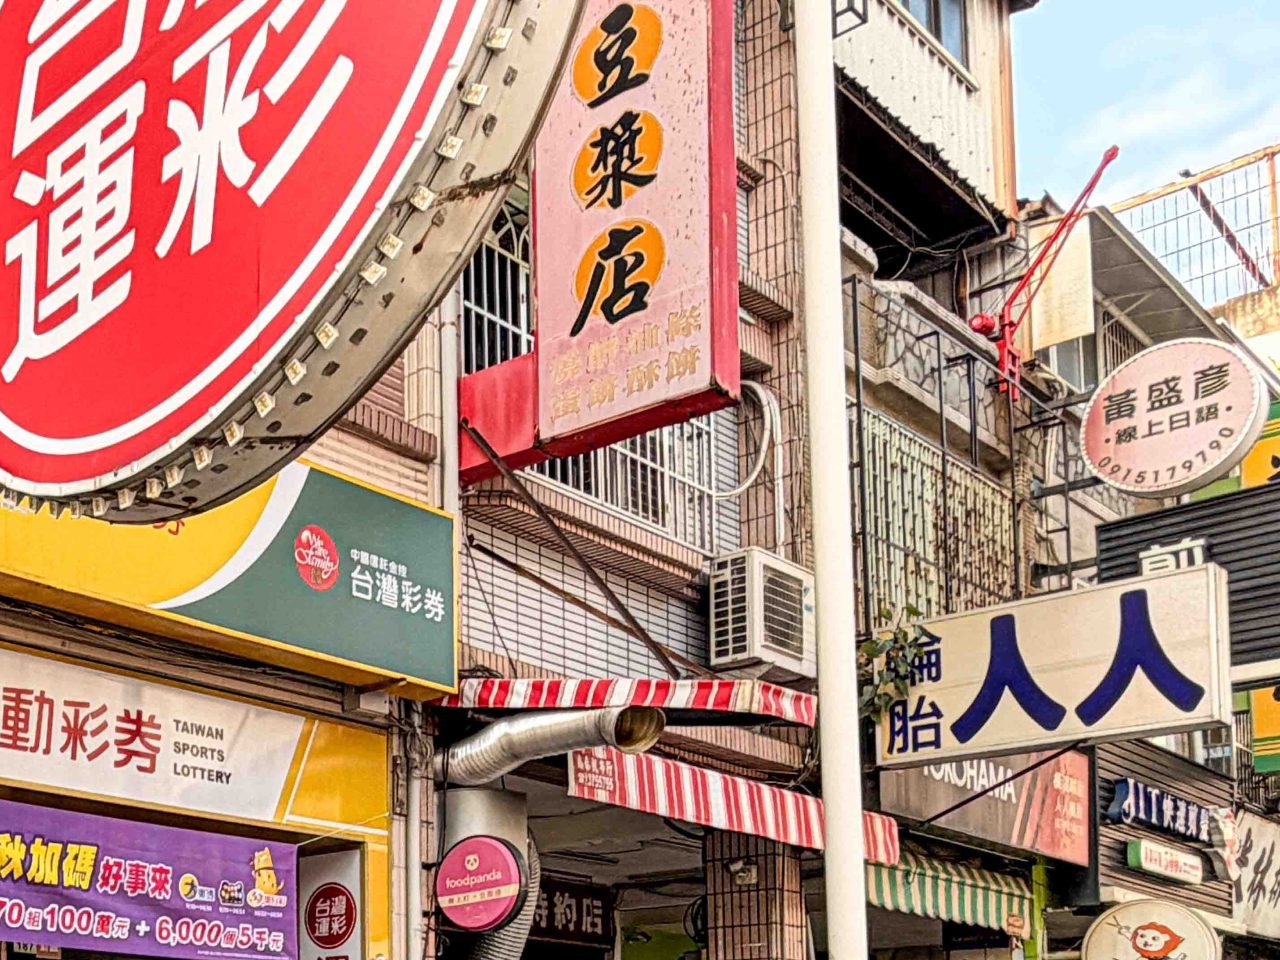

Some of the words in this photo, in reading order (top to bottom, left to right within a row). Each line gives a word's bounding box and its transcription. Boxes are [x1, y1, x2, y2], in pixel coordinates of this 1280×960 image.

[1, 0, 354, 383] 運彩
[1115, 403, 1219, 445] 線上日語
[1098, 427, 1234, 484] 0915179790
[351, 565, 446, 623] 台灣彩券
[950, 589, 1206, 744] 人人
[173, 718, 224, 741] TAIWAN
[173, 742, 225, 763] SPORTS
[173, 762, 232, 785] LOTTERY
[923, 759, 1017, 804] OKOHAMA
[98, 856, 173, 900] 好事來
[446, 869, 503, 889] foodpanda
[315, 915, 347, 937] 運彩
